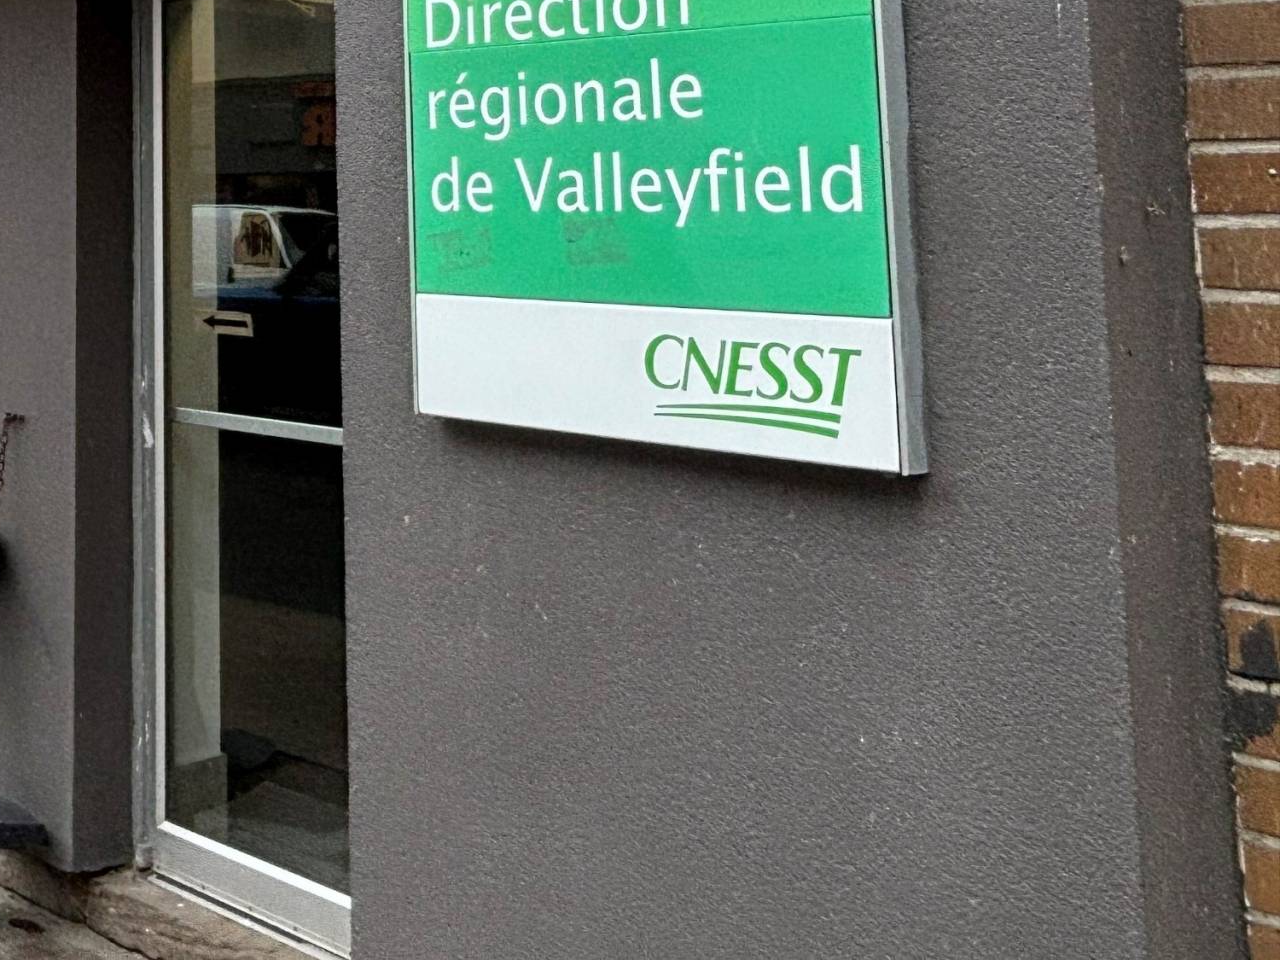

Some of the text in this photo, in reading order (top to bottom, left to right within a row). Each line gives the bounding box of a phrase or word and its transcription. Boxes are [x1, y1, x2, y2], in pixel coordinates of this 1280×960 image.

[427, 57, 705, 143] régionale
[430, 143, 864, 229] de Valleyfield
[644, 334, 862, 407] CNESST
